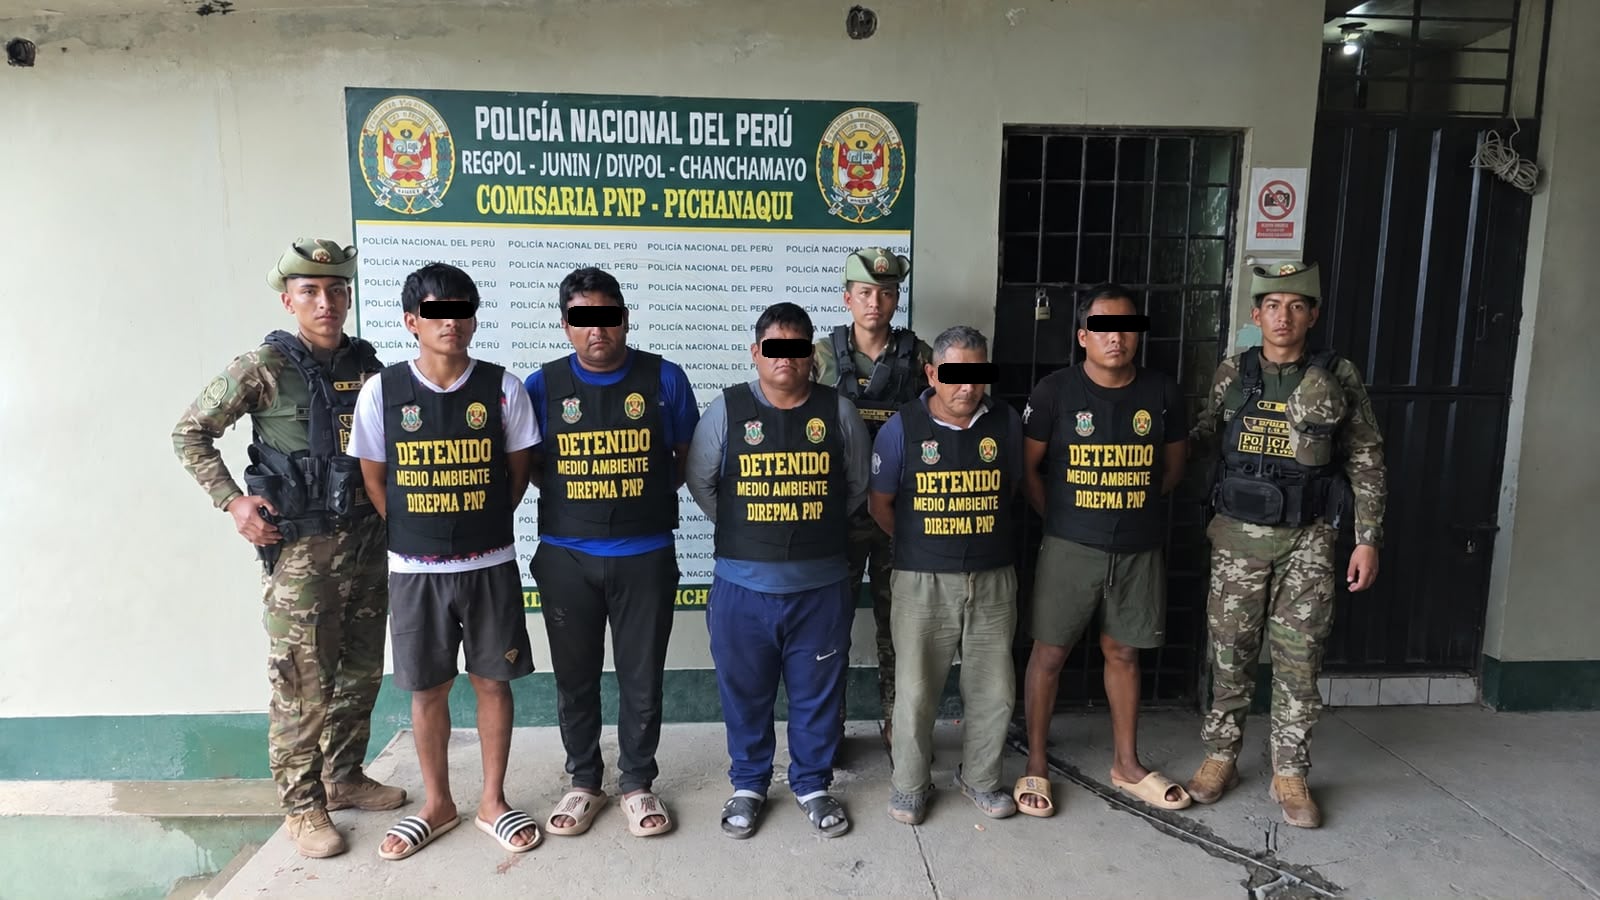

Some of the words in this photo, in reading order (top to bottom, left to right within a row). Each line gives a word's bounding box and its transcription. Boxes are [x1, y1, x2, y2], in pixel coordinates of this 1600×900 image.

[475, 100, 564, 142] POLICÍA
[570, 108, 683, 145] NACIONAL
[689, 111, 730, 146] DEL
[736, 107, 793, 147] PERÚ
[461, 149, 526, 175] REGPOL
[540, 151, 590, 177] JUNIN
[594, 152, 602, 179] /
[606, 152, 666, 179] DIVPOL
[679, 154, 807, 182] CHANCHAMAYO
[476, 183, 599, 217] COMISARIA
[602, 187, 647, 217] PNP
[663, 187, 794, 223] PICHANAQUI
[363, 237, 399, 245] POLICÍA
[401, 238, 448, 247] NACIONAL
[450, 239, 468, 247] DEL
[470, 238, 496, 248] PERÚ
[508, 240, 544, 248] POLICÍA
[546, 241, 592, 250] NACIONAL
[647, 242, 682, 251] POLICÍA
[684, 243, 728, 252] NACIONAL
[750, 243, 773, 252] PERÚ
[786, 245, 819, 253] POLICÍA
[364, 258, 400, 266] POLICÍA
[471, 258, 496, 268] PERÚ
[509, 260, 545, 269] POLICÍA
[648, 263, 682, 271] POLICÍA
[684, 264, 728, 272] NACIONAL
[750, 264, 773, 272] PERÚ
[786, 265, 819, 273] POLICÍA
[364, 278, 400, 286] POLICÍA
[510, 281, 545, 289] POLICÍA
[648, 283, 682, 291] POLICÍA
[684, 284, 728, 292] NACIONAL
[750, 284, 773, 293] PERÚ
[365, 298, 402, 307] POLICÍA
[479, 300, 498, 309] ERÚ
[510, 301, 546, 309] POLICÍA
[648, 303, 682, 311] POLICÍA
[685, 304, 728, 312] NACIONAL
[366, 320, 402, 328] POLICÍA
[478, 320, 499, 329] ERÚ
[511, 321, 546, 329] POLICÍA
[649, 323, 683, 331] POLICÍA
[685, 324, 728, 332] NACIONAL
[475, 340, 500, 349] PERÚ
[512, 341, 547, 349] POLICÍA
[649, 342, 683, 351] POLICÍA
[686, 344, 728, 352] NACIONAL
[557, 428, 651, 456] DETENIDO
[396, 438, 492, 466] DETENIDO
[1068, 444, 1154, 467] DETENIDO
[557, 459, 589, 476] MEDIO
[591, 457, 649, 476] AMBIENTE
[738, 451, 830, 477] DETENIDO
[396, 470, 429, 487] MEDIO
[432, 468, 491, 487] AMBIENTE
[915, 469, 1001, 494] DETENIDO
[1066, 468, 1098, 486] MEDIO
[1100, 471, 1151, 487] AMBIENTE
[566, 480, 618, 500] DIREPMA
[621, 478, 644, 498] PNP
[737, 481, 770, 497] MEDIO
[772, 480, 828, 497] AMBIENTE
[407, 492, 460, 513] DIREPMA
[463, 490, 486, 511] PNP
[913, 496, 945, 512] MEDIO
[948, 495, 999, 512] AMBIENTE
[1075, 489, 1123, 509] DIREPMA
[1126, 490, 1146, 509] PNP
[747, 502, 799, 522] DIREPMA
[802, 501, 824, 520] PNP
[924, 516, 973, 535] DIREPMA
[975, 515, 995, 534] PNP
